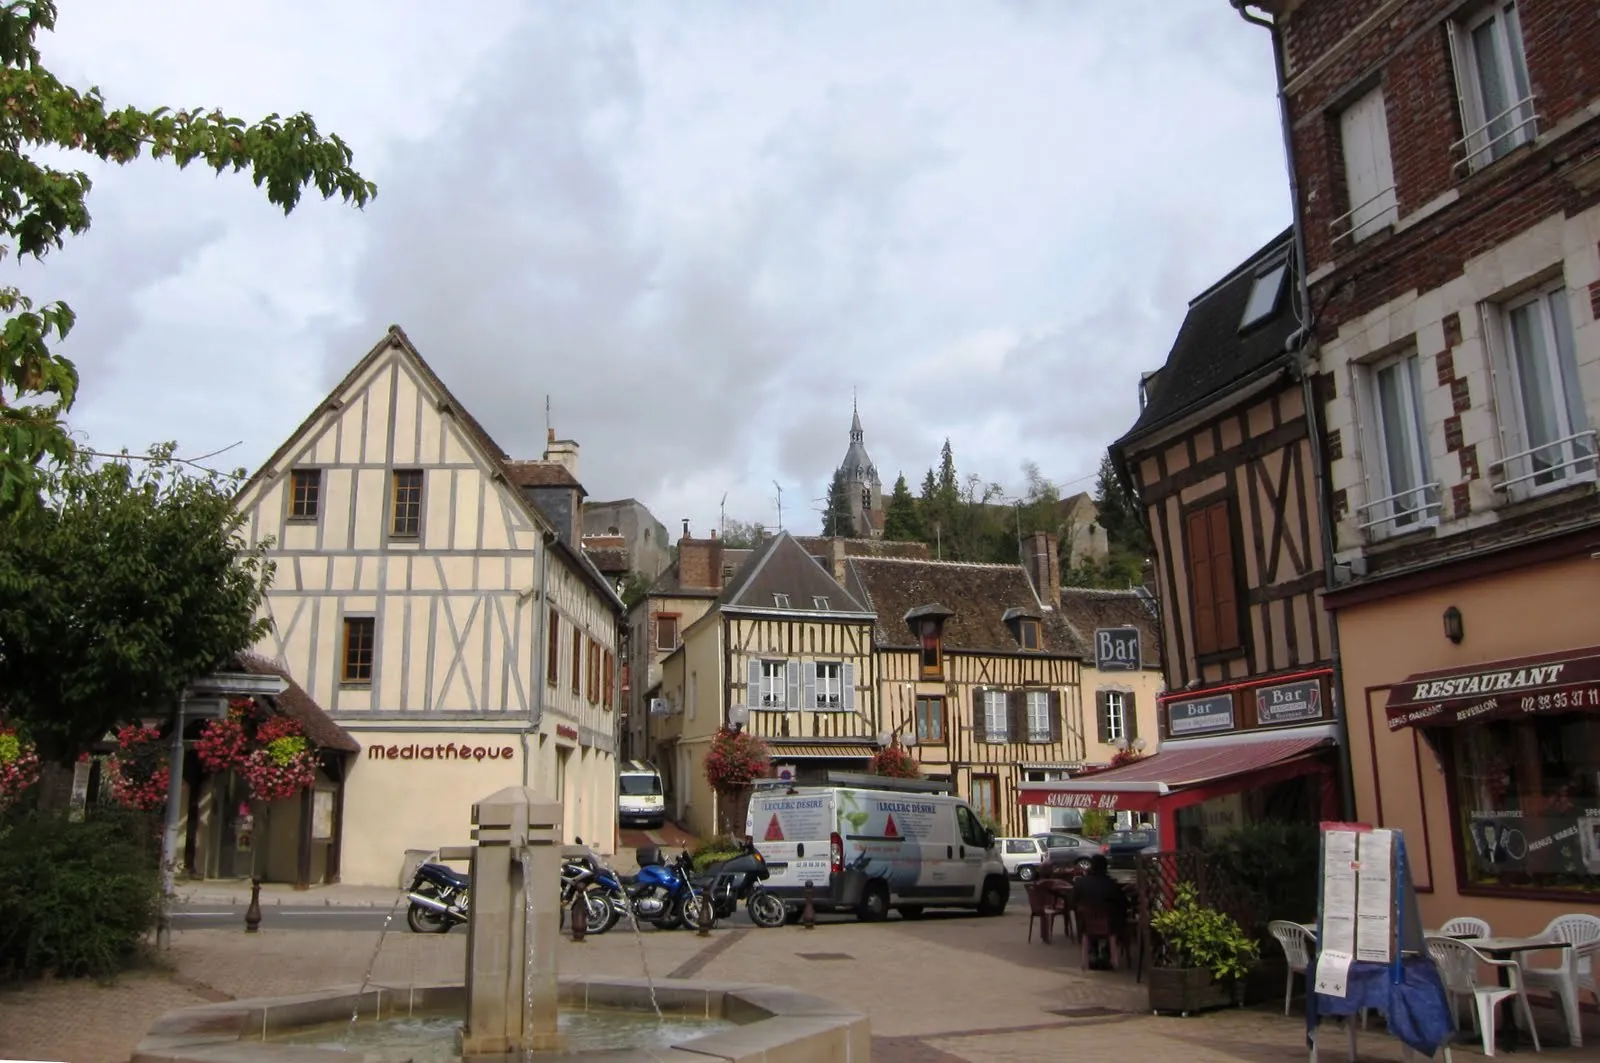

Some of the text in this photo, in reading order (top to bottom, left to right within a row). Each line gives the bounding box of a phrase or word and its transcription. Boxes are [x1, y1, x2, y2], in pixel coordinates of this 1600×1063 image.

[1098, 631, 1137, 661] Bar
[1412, 665, 1564, 700] RESTAURANT
[1272, 689, 1302, 704] Bar
[1521, 688, 1599, 712] 02 38 95 37 11
[1187, 703, 1212, 716] Bar
[764, 801, 795, 811] LECLERC
[879, 802, 911, 812] LECLERC
[1045, 792, 1094, 807] SANDWICHS
[1098, 793, 1119, 808] BAR
